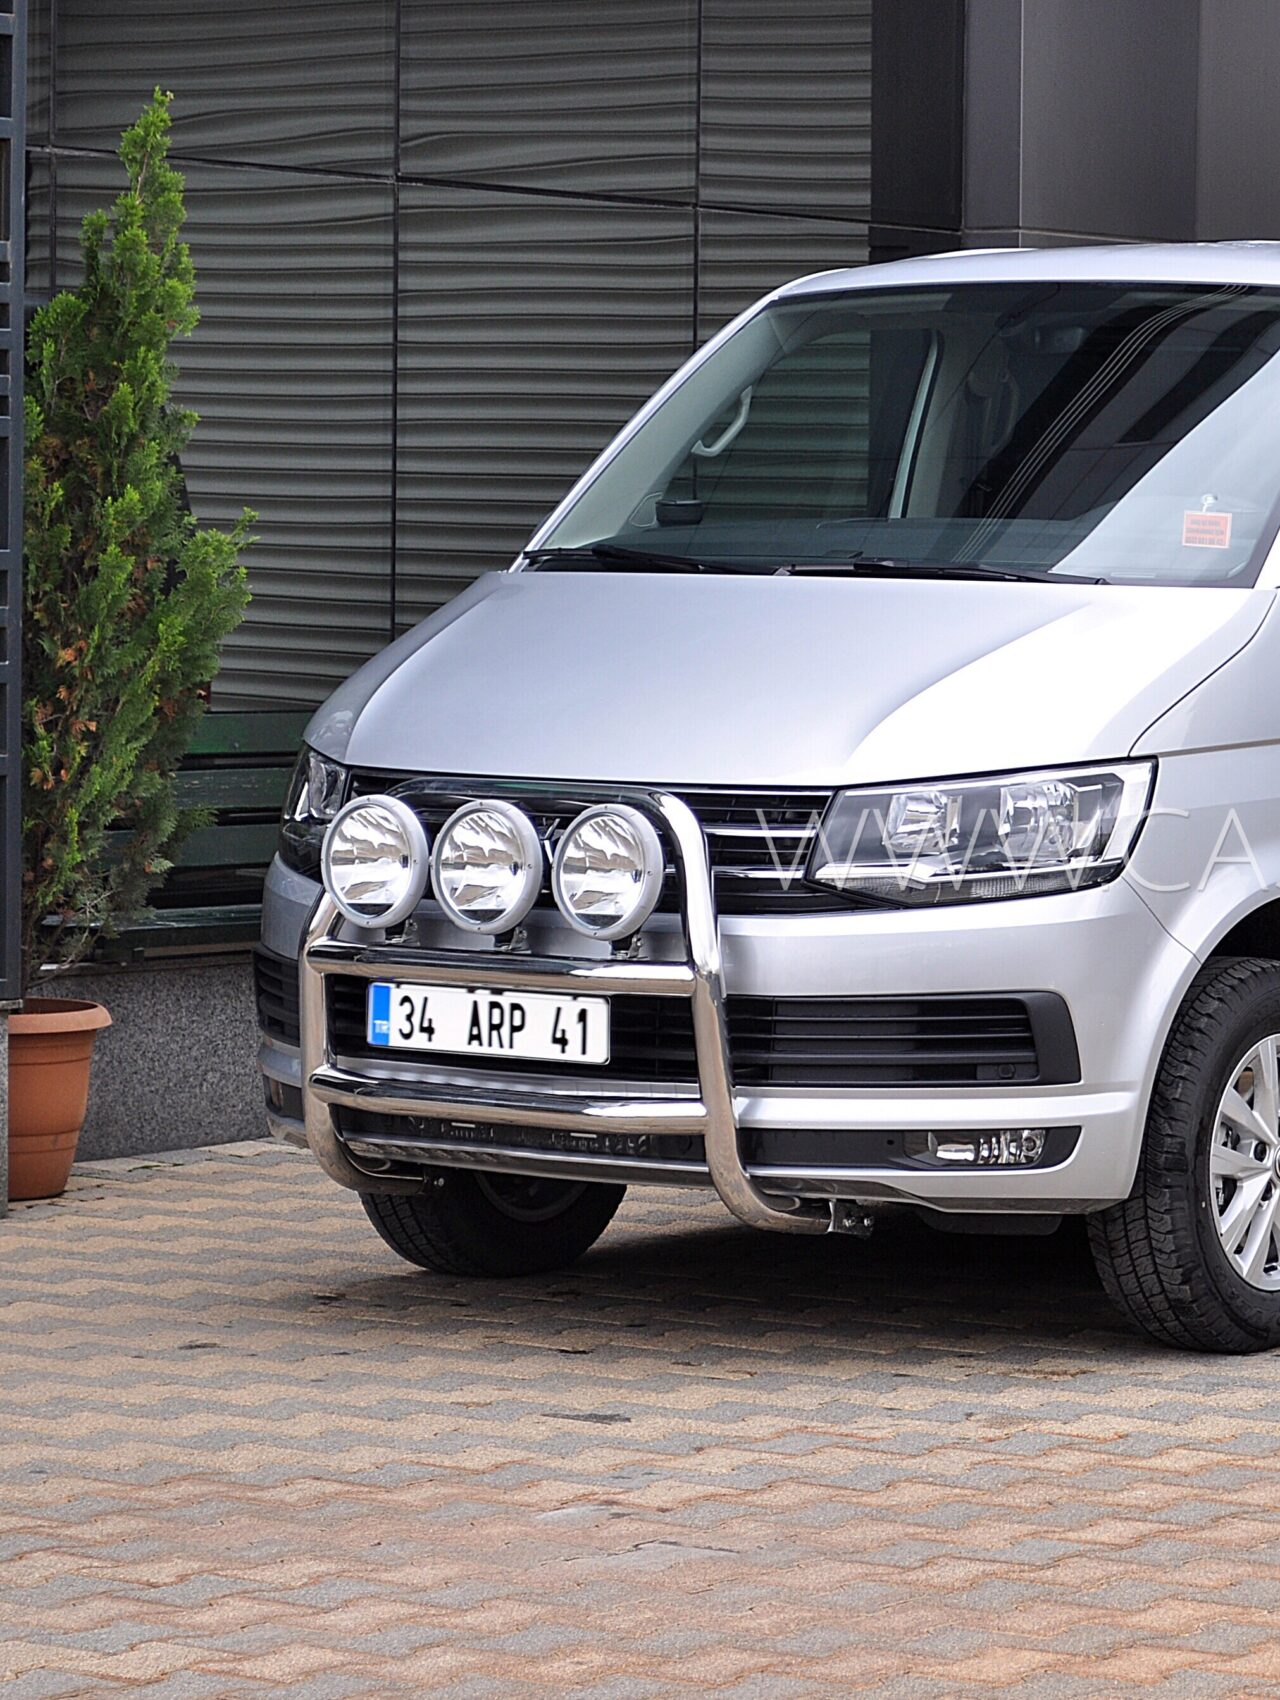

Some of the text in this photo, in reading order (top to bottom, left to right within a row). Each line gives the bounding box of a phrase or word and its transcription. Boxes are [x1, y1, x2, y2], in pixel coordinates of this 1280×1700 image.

[398, 995, 435, 1042] 34
[467, 1000, 526, 1049] ARP
[551, 1006, 588, 1055] 41
